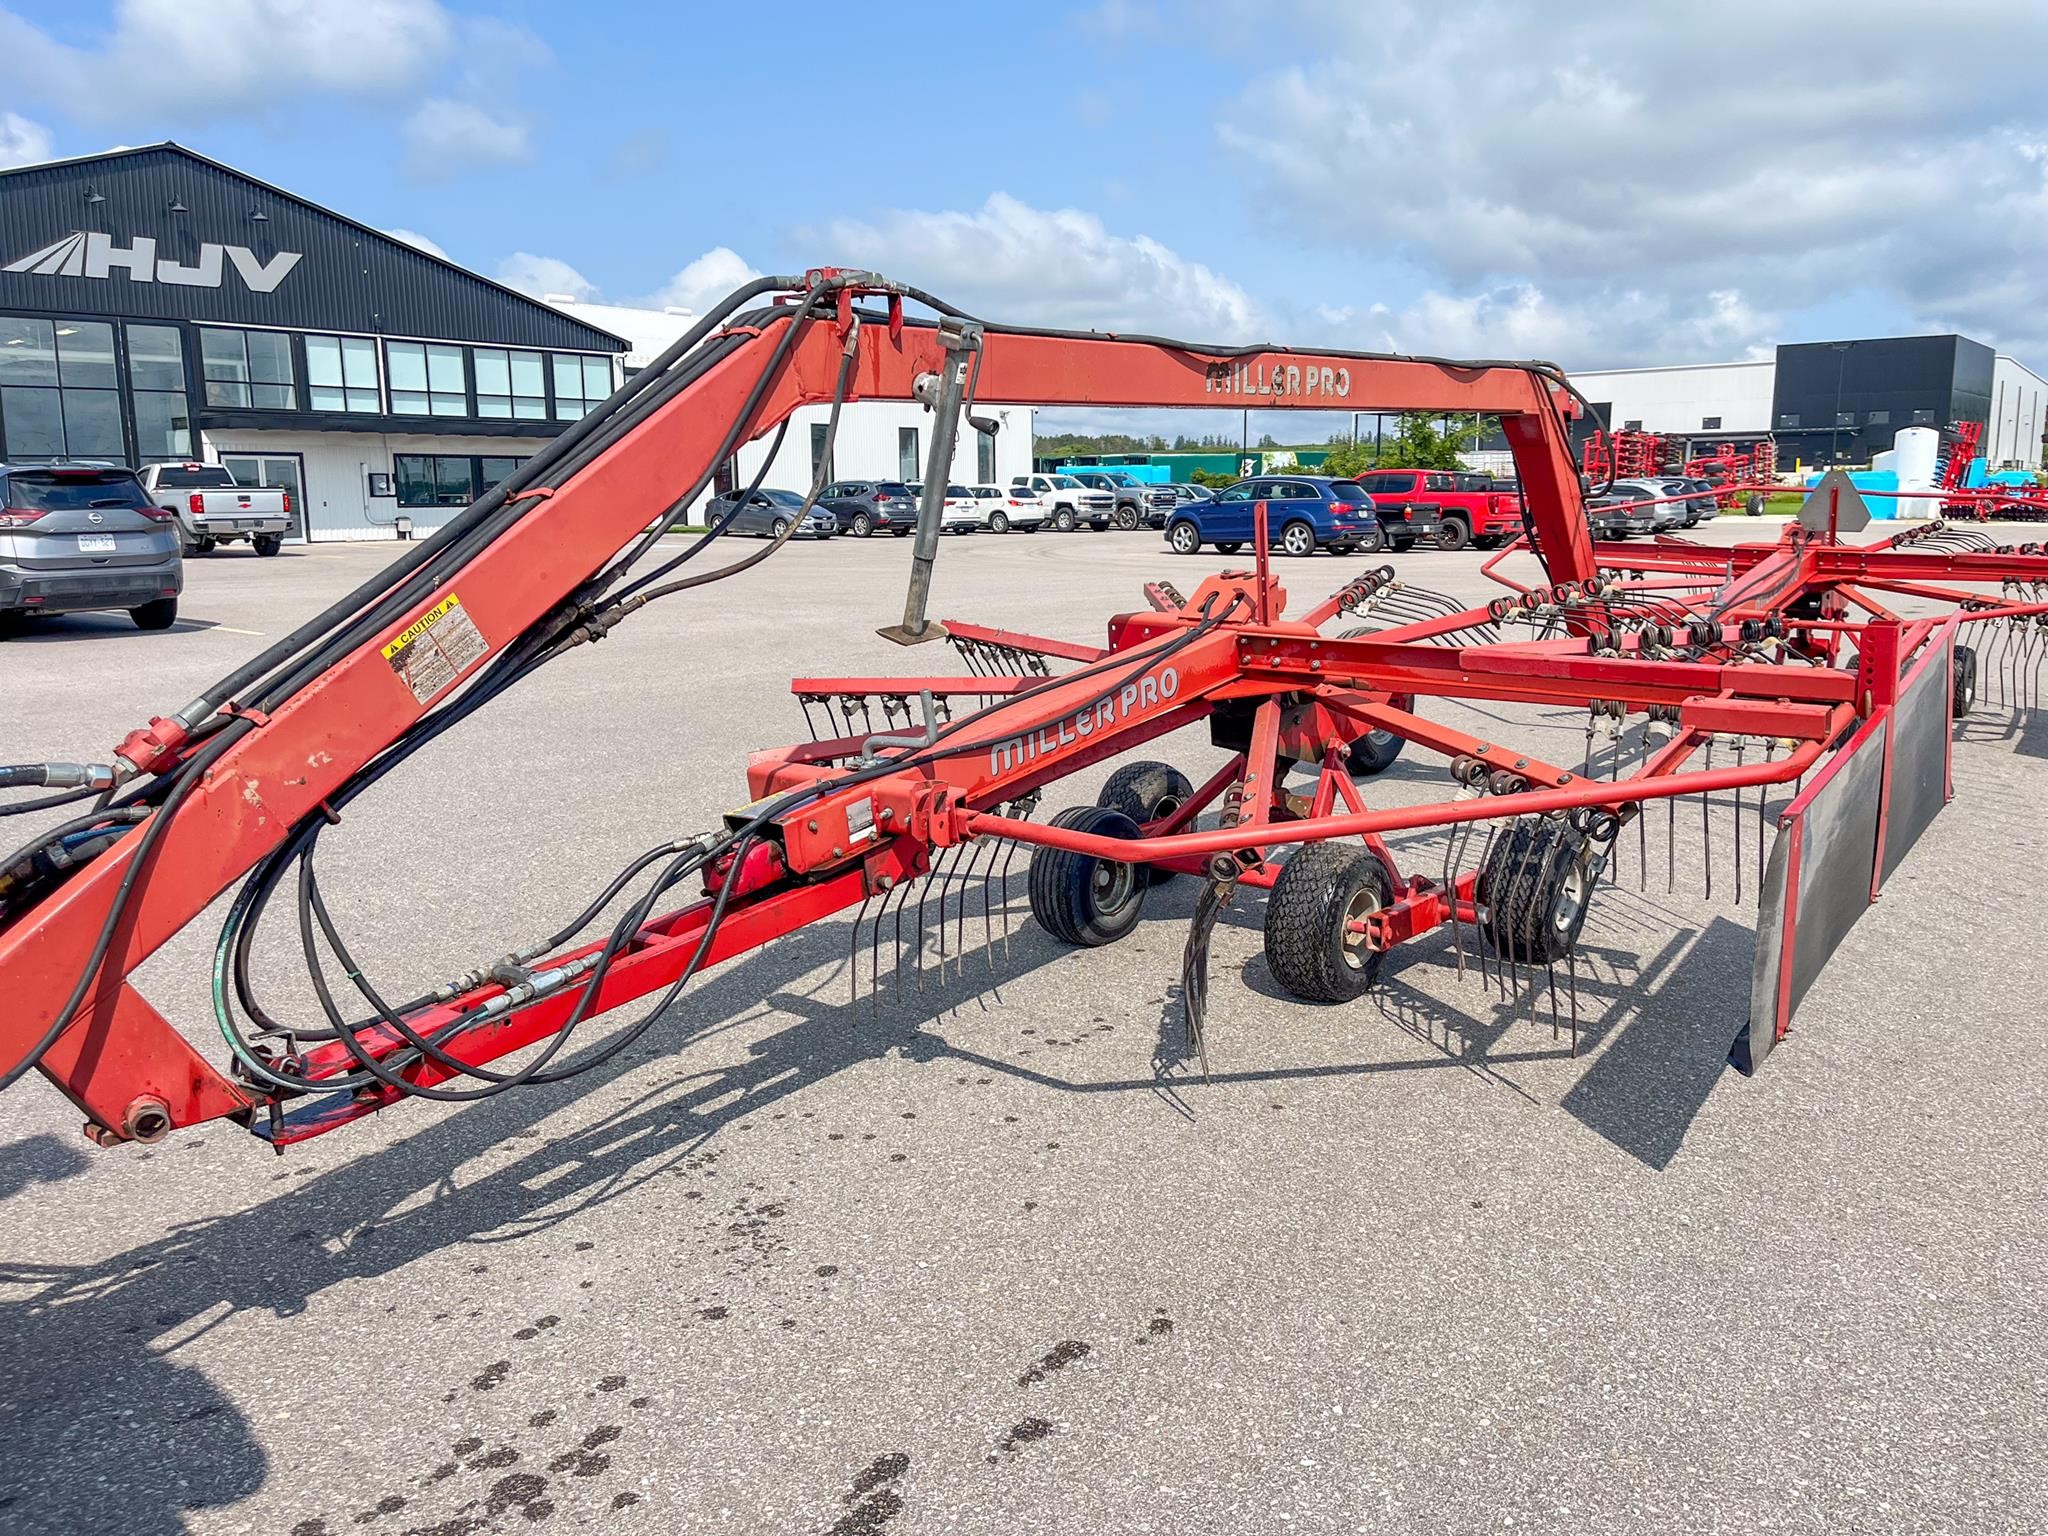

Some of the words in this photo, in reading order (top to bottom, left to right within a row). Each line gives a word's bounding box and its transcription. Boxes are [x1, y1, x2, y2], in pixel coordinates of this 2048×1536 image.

[85, 232, 303, 293] HJV
[1206, 362, 1301, 396] MILLER
[1306, 366, 1350, 397] PRO
[400, 607, 443, 644] CAUTION
[990, 696, 1115, 776] MILLER
[1120, 667, 1179, 717] PRO
